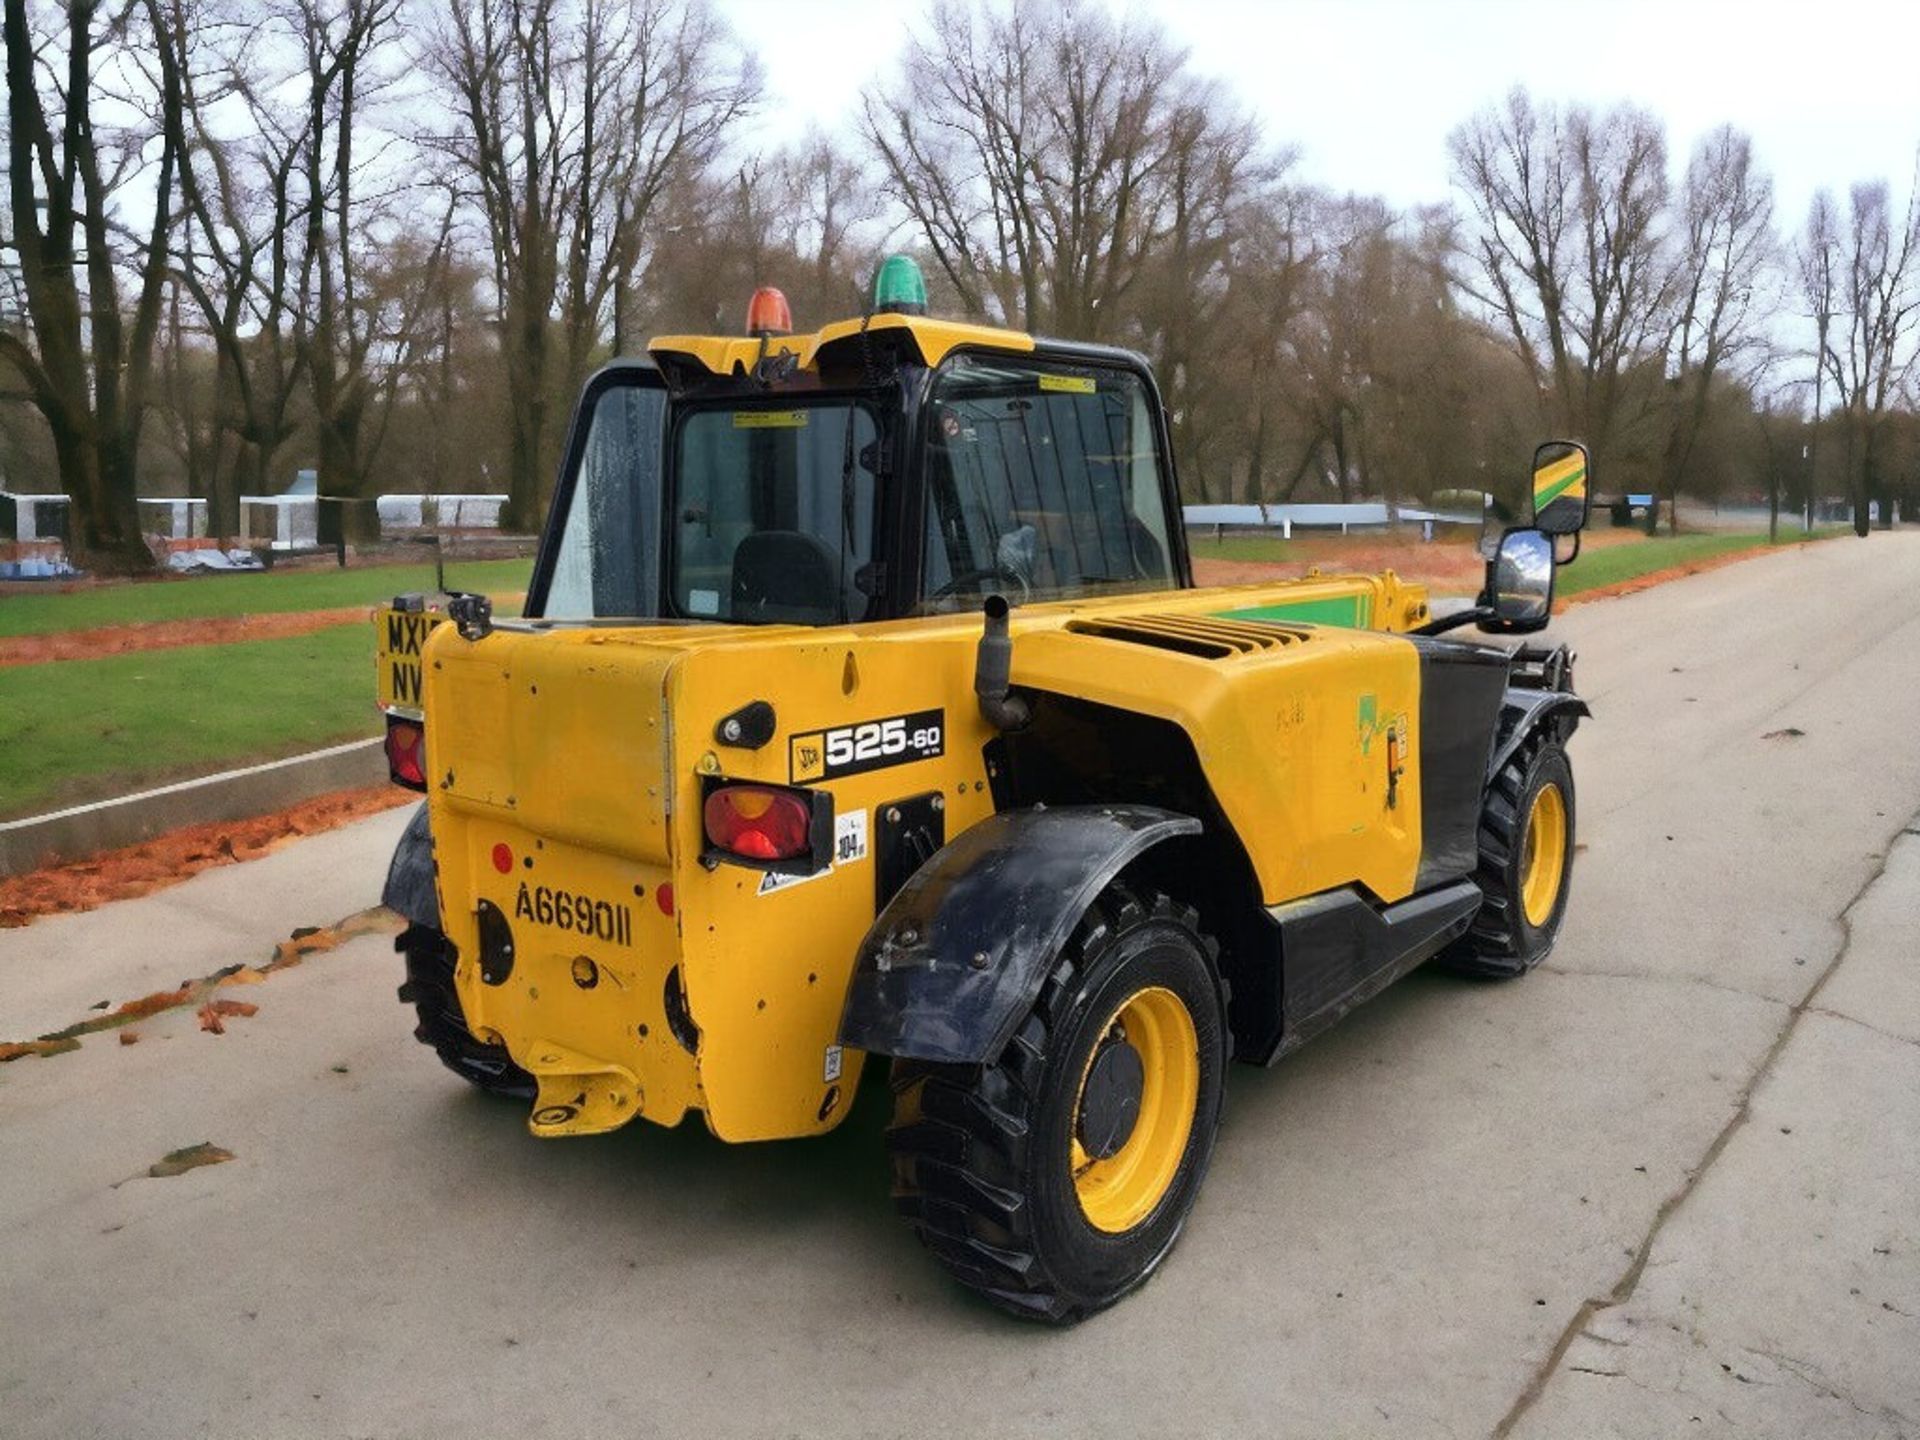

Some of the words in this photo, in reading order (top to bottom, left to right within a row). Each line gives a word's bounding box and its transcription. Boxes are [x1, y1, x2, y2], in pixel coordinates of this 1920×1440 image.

[389, 615, 440, 656] MX1
[826, 718, 940, 766] 525-60
[515, 881, 631, 947] A669011
